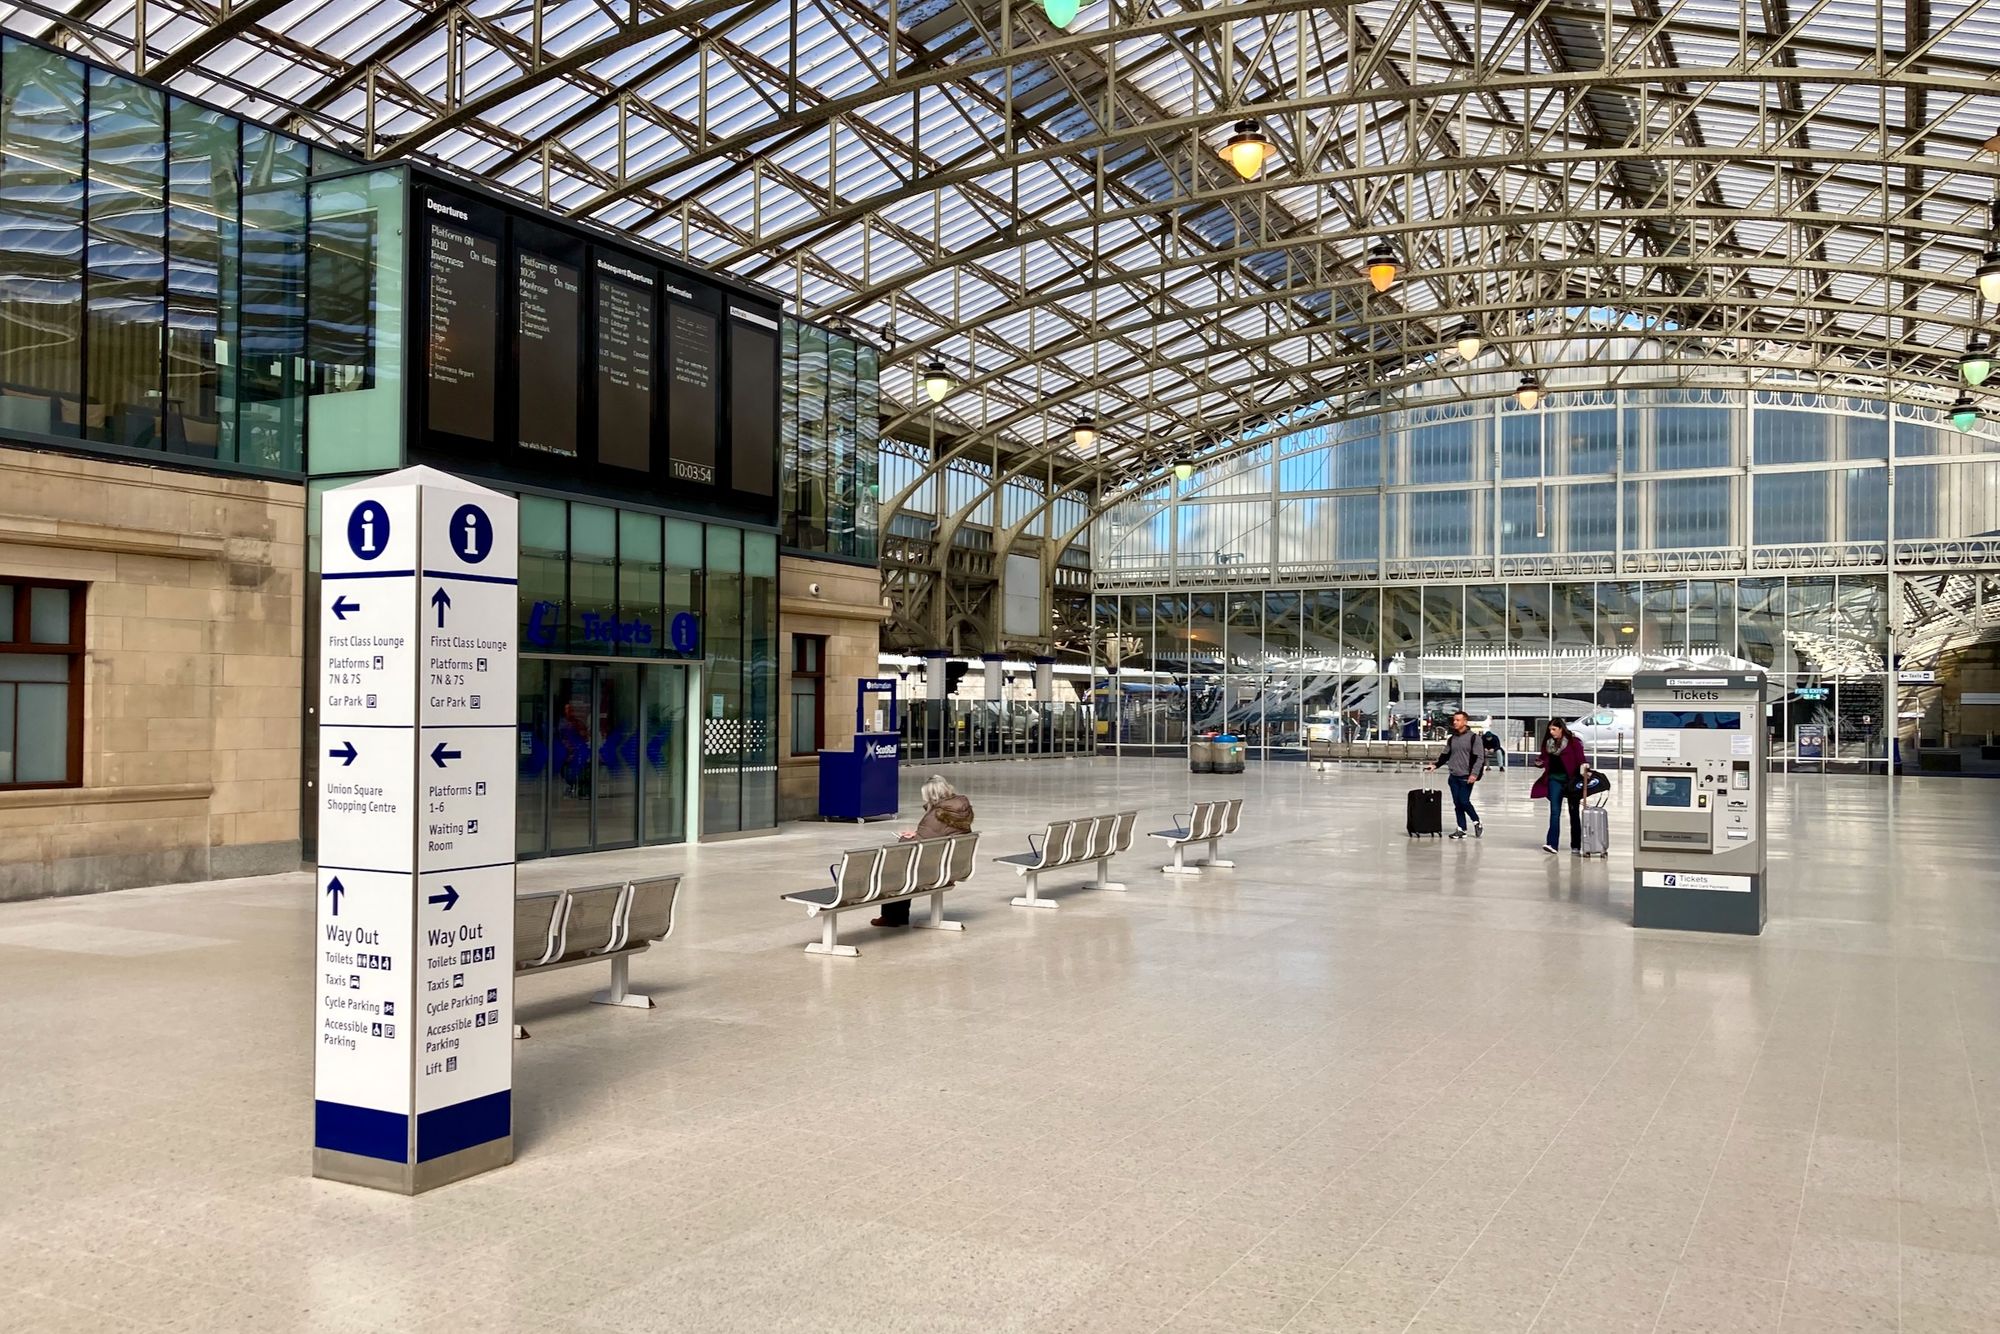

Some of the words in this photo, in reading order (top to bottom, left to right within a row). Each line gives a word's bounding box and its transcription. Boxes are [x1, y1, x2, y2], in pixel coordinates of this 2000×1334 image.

[427, 198, 468, 220] Departures
[431, 224, 463, 243] Platform
[464, 236, 474, 247] 6N
[431, 237, 449, 251] 10:10
[431, 249, 464, 268] Inverness
[470, 250, 480, 261] On
[481, 254, 497, 267] time
[520, 254, 548, 271] Platform
[549, 264, 558, 275] 6S
[597, 259, 627, 276] Subsequent
[627, 269, 653, 285] Departures
[519, 278, 548, 295] Montrose
[554, 278, 563, 288] On
[564, 282, 578, 293] time
[667, 284, 692, 299] Information
[674, 462, 711, 482] 10:03:54
[581, 611, 652, 644] Tickets
[329, 636, 348, 647] First
[350, 636, 372, 647] Class
[373, 636, 404, 649] Lounge
[431, 636, 451, 648] First
[453, 637, 474, 649] Class
[477, 638, 507, 652] Lounge
[329, 658, 370, 669] Platforms
[431, 658, 473, 670] Platforms
[329, 674, 340, 685] 7N
[342, 674, 349, 684] &
[350, 674, 361, 684] 7S
[431, 674, 443, 685] 7N
[445, 674, 451, 685] &
[454, 675, 464, 685] 7S
[329, 696, 342, 707] Car
[344, 695, 362, 706] Park
[431, 696, 445, 708] Car
[447, 696, 466, 707] Park
[1672, 690, 1719, 700] Tickets
[327, 783, 352, 794] Union
[354, 784, 383, 797] Square
[429, 786, 472, 797] Platforms
[327, 799, 367, 814] Shopping
[368, 800, 396, 813] Centre
[430, 802, 444, 813] 1-6
[429, 823, 464, 835] Waiting
[429, 841, 453, 852] Room
[326, 924, 352, 947] Way
[355, 927, 379, 945] Out
[428, 929, 456, 947] Way
[460, 924, 483, 940] Out
[326, 952, 353, 965] Toilets
[428, 956, 457, 969] Toilets
[325, 974, 346, 986] Taxis
[428, 979, 449, 991] Taxis
[325, 996, 346, 1009] Cycle
[348, 999, 380, 1015] Parking
[427, 1002, 449, 1016] Cycle
[451, 994, 484, 1010] Parking
[325, 1018, 368, 1033] Accessible
[427, 1019, 472, 1036] Accessible
[324, 1034, 356, 1050] Parking
[426, 1037, 459, 1053] Parking
[426, 1064, 442, 1075] Lift
